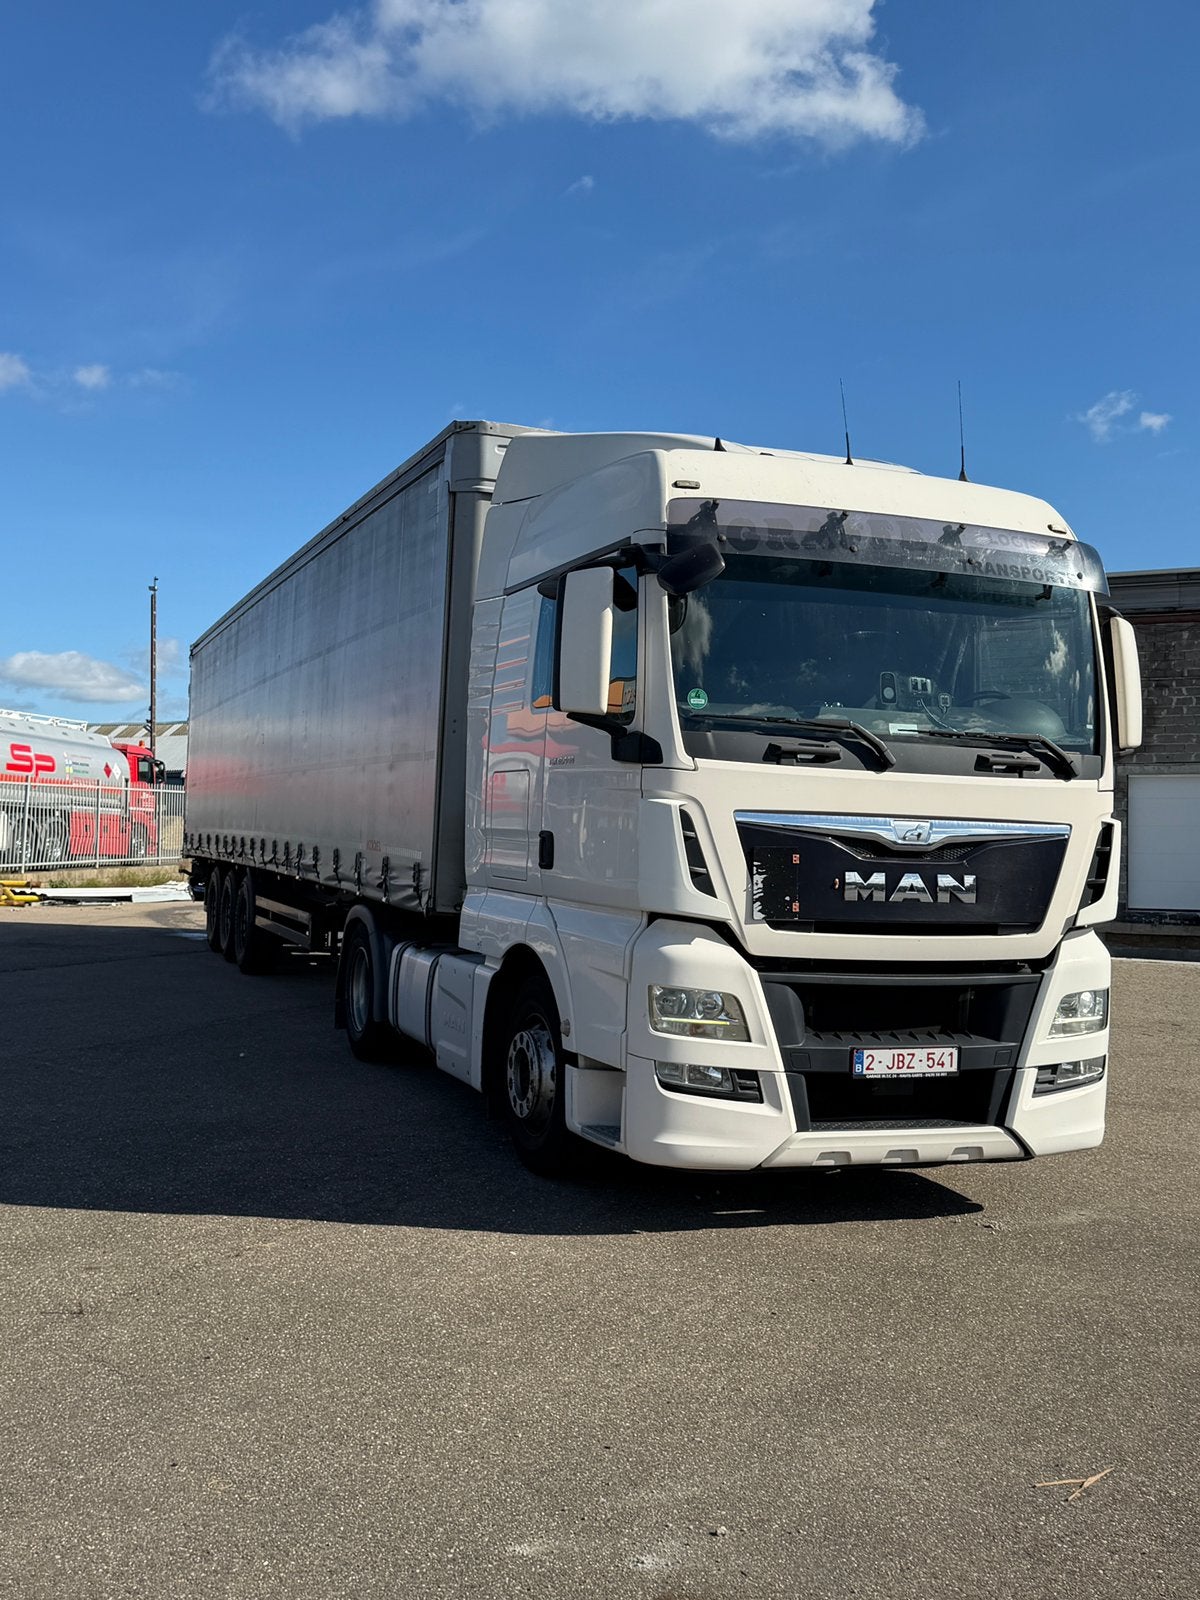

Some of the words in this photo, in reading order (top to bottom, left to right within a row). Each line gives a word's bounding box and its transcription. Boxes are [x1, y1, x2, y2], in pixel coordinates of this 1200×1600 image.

[6, 744, 56, 780] SP
[845, 872, 976, 904] MAN
[855, 1064, 862, 1072] B
[866, 1052, 954, 1071] 2-JBZ-541
